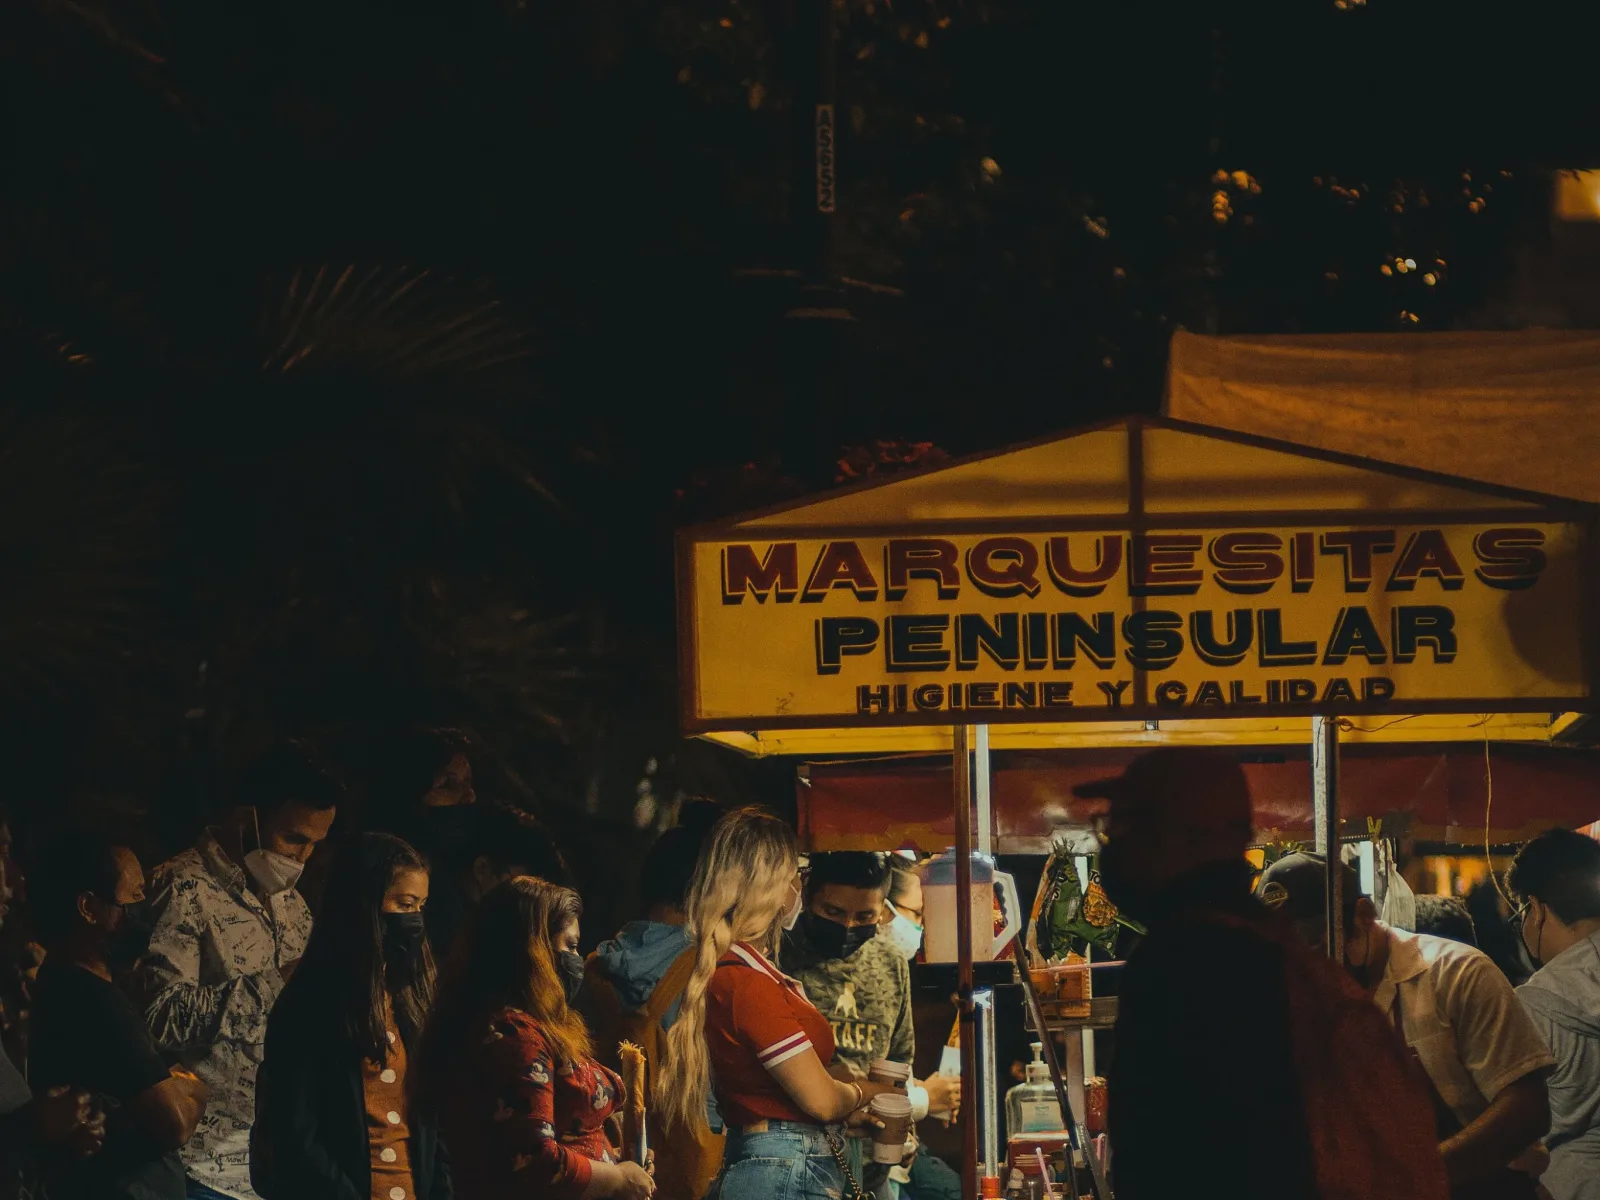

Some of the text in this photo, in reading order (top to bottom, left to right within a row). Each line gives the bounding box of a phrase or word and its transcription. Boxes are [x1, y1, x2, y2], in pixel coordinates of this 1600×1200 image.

[720, 527, 1547, 606] MARQUESITAS
[814, 604, 1458, 676] PENINSULAR
[856, 676, 1395, 715] HIGIENE Y CALIDAD
[829, 1020, 878, 1052] TAFF
